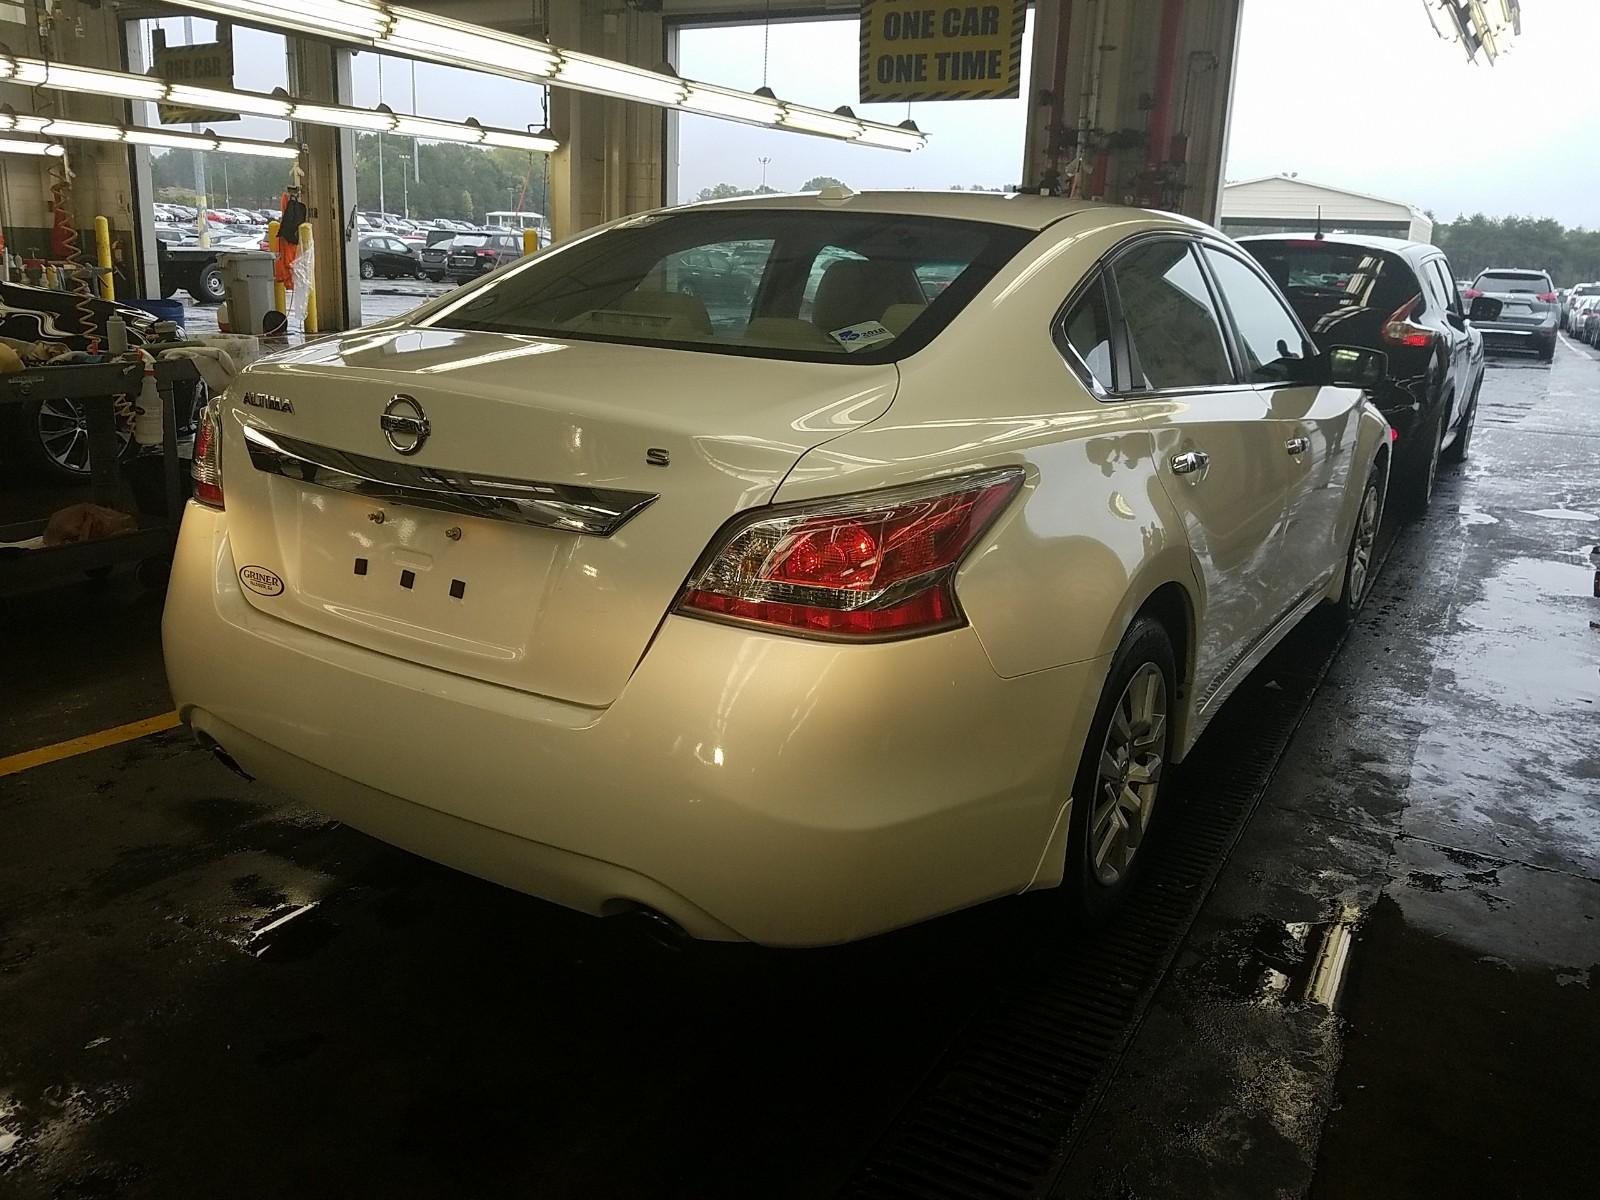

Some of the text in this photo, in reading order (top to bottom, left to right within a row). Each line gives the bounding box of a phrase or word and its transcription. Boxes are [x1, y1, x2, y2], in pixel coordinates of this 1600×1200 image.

[883, 5, 1000, 41] ONE CAR
[165, 56, 221, 80] ONE CAR
[877, 49, 1003, 84] ONE TIME
[243, 392, 295, 415] ALTIMA
[646, 448, 670, 467] S
[243, 569, 279, 586] GRINER
